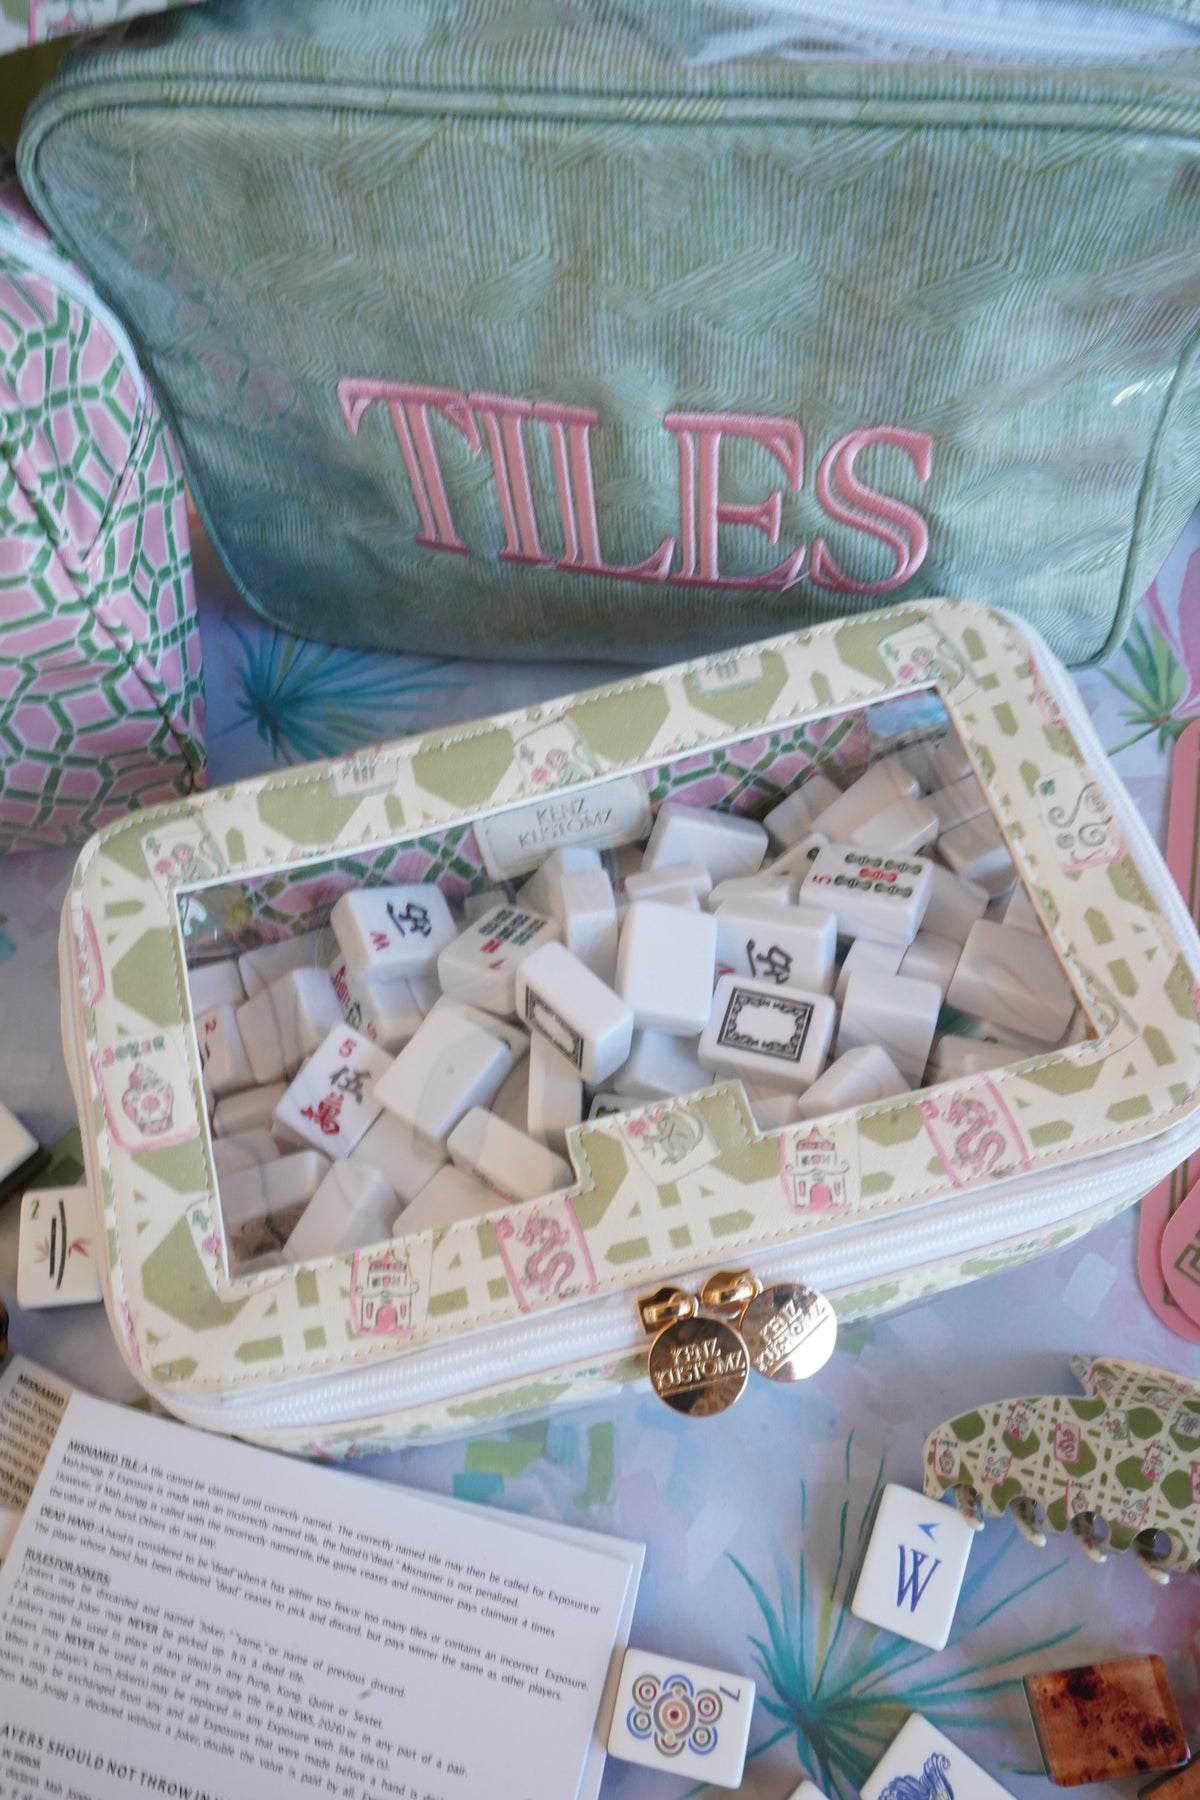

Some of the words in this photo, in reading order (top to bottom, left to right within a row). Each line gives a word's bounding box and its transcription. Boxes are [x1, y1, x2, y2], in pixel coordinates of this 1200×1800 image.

[337, 377, 933, 594] TILES
[338, 1039, 357, 1058] 5
[670, 1336, 722, 1366] KENZ
[226, 1508, 269, 1530] incorrectly
[272, 1524, 302, 1540] named
[304, 1532, 319, 1546] tile,
[322, 1538, 337, 1550] the
[339, 1542, 362, 1558] hand
[401, 1562, 443, 1583] Misnamer
[457, 1582, 472, 1593] not
[475, 1588, 520, 1608] penalized.
[242, 1496, 262, 1509] until
[264, 1504, 298, 1522] correctly
[302, 1516, 333, 1531] named.
[338, 1525, 353, 1538] The
[356, 1533, 391, 1551] correctly
[395, 1544, 426, 1560] named
[428, 1554, 442, 1565] tile
[444, 1560, 463, 1573] may
[466, 1565, 486, 1579] then
[503, 1578, 530, 1593] called
[532, 1585, 544, 1597] for
[548, 1590, 589, 1611] Exposure
[224, 1525, 266, 1547] incorrectly
[270, 1540, 300, 1557] named
[316, 1553, 330, 1566] the
[332, 1561, 357, 1574] game
[360, 1570, 388, 1584] ceases
[391, 1579, 409, 1591] and
[411, 1585, 454, 1605] misnamer
[456, 1600, 477, 1613] pays
[481, 1607, 518, 1625] claimant
[531, 1622, 555, 1637] times
[896, 1544, 940, 1614] W
[237, 1571, 260, 1586] when
[270, 1580, 285, 1594] has
[288, 1588, 313, 1602] either
[316, 1596, 331, 1609] too
[334, 1601, 349, 1615] few
[364, 1611, 379, 1624] too
[382, 1618, 405, 1634] many
[409, 1626, 427, 1640] tiles
[444, 1639, 481, 1657] contains
[500, 1655, 539, 1675] incorrect
[545, 1668, 589, 1691] Exposure.
[244, 1592, 272, 1607] ceases
[287, 1606, 305, 1618] pick
[309, 1612, 327, 1625] and
[329, 1617, 363, 1637] discard,
[366, 1628, 381, 1643] but
[384, 1637, 405, 1650] pays
[408, 1644, 438, 1660] winner
[442, 1653, 457, 1666] the
[460, 1661, 484, 1675] same
[501, 1674, 525, 1688] other
[528, 1682, 562, 1701] players.
[370, 1678, 407, 1699] discard.
[718, 1685, 742, 1703] 7
[353, 1710, 384, 1730] Sextet.
[47, 1740, 104, 1770] SHOULD
[106, 1760, 136, 1781] NOT
[140, 1772, 192, 1800] THROW
[338, 1744, 355, 1758] like
[360, 1752, 375, 1765] tile
[396, 1746, 417, 1760] part
[446, 1763, 467, 1777] pair.
[335, 1762, 366, 1782] before
[381, 1778, 406, 1796] hand
